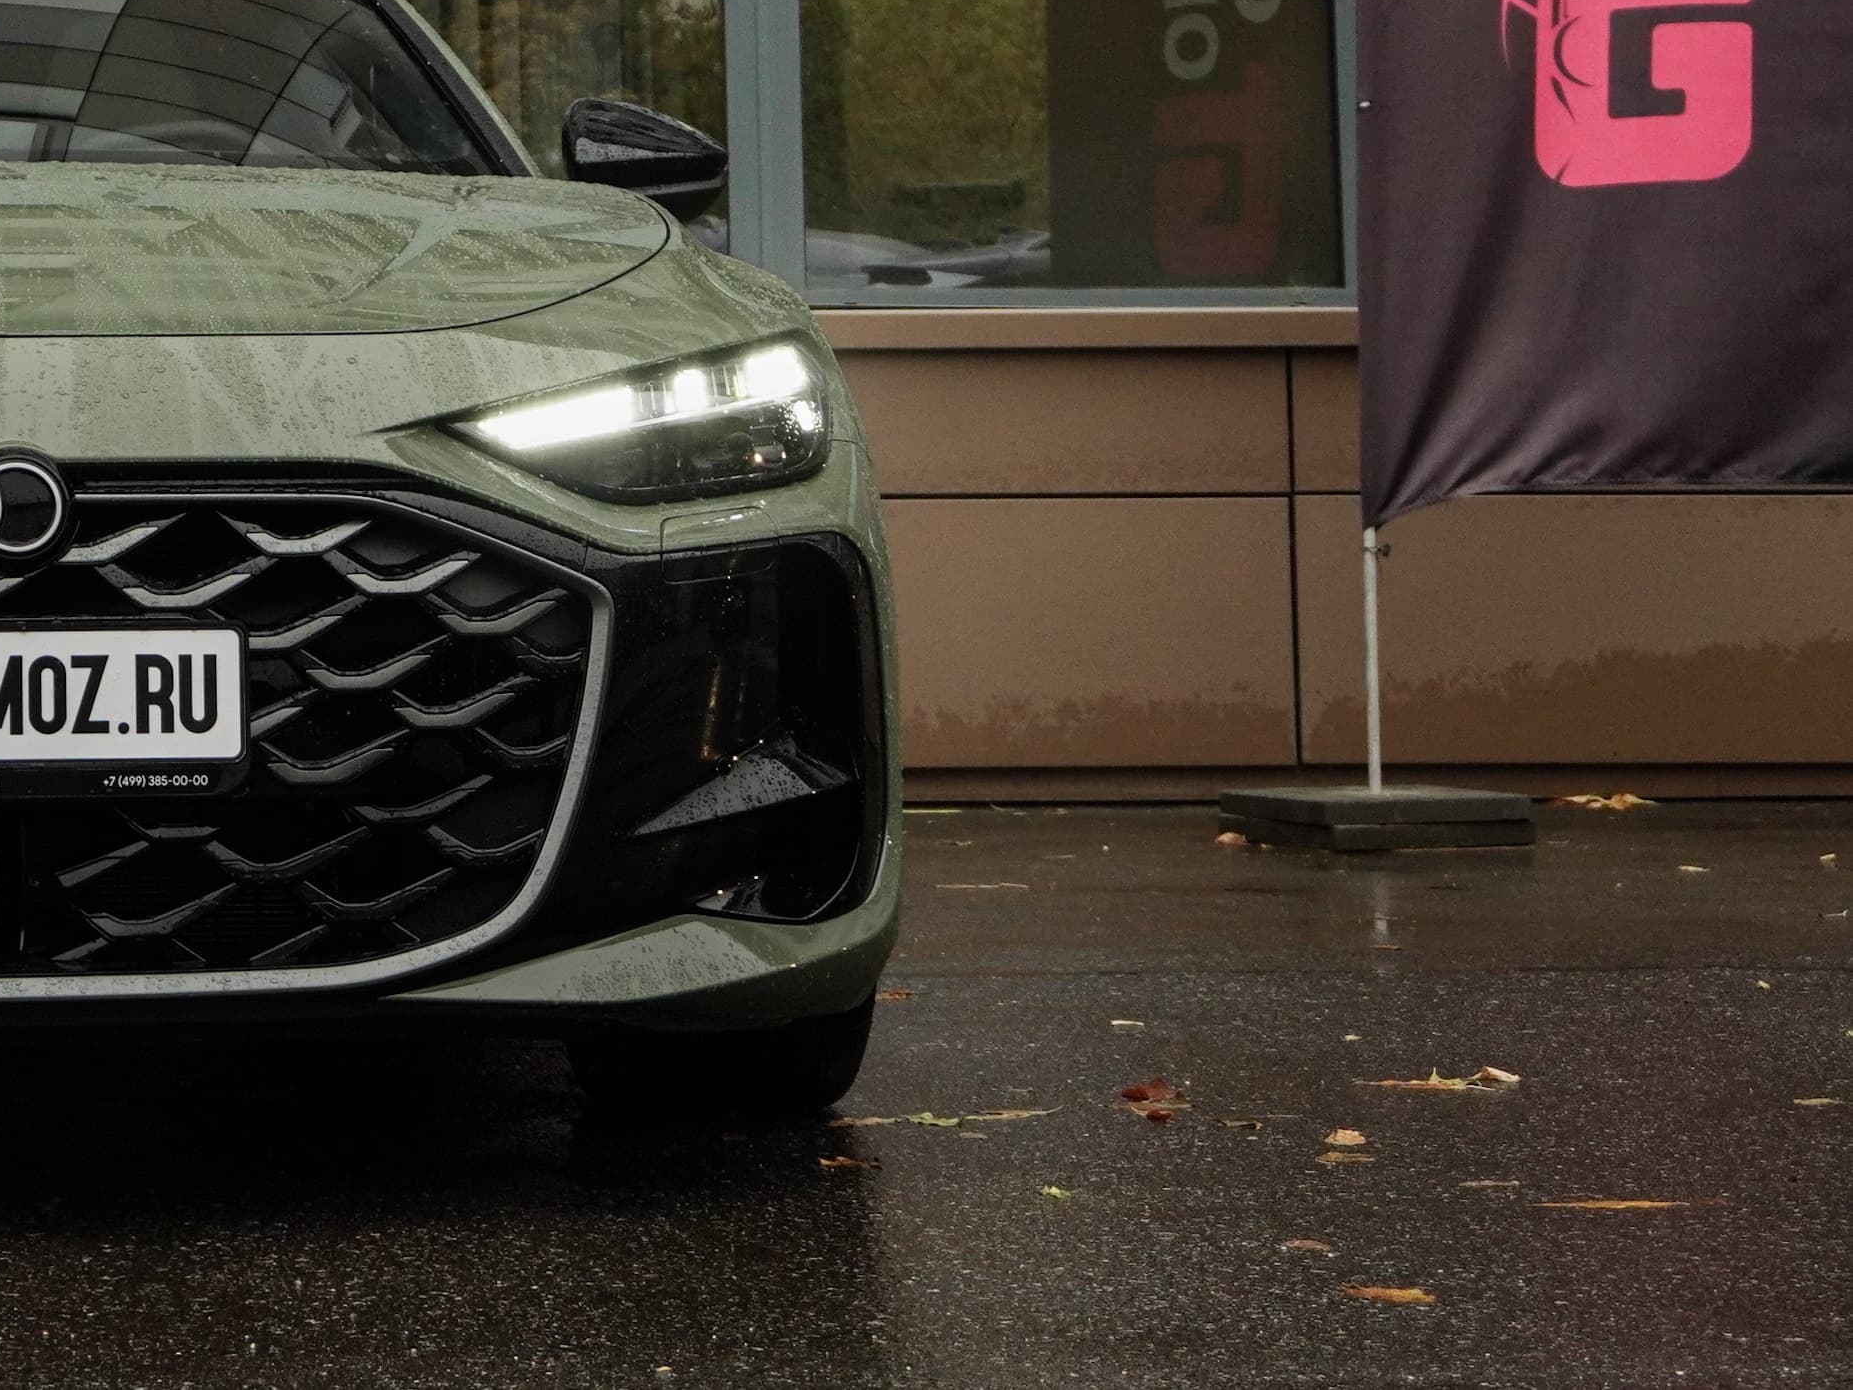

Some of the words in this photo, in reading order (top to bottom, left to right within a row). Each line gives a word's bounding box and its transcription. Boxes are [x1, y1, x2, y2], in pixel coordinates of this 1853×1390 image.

[103, 775, 116, 787] +7
[118, 774, 146, 788] (499)
[148, 774, 209, 787] 385-00-00
